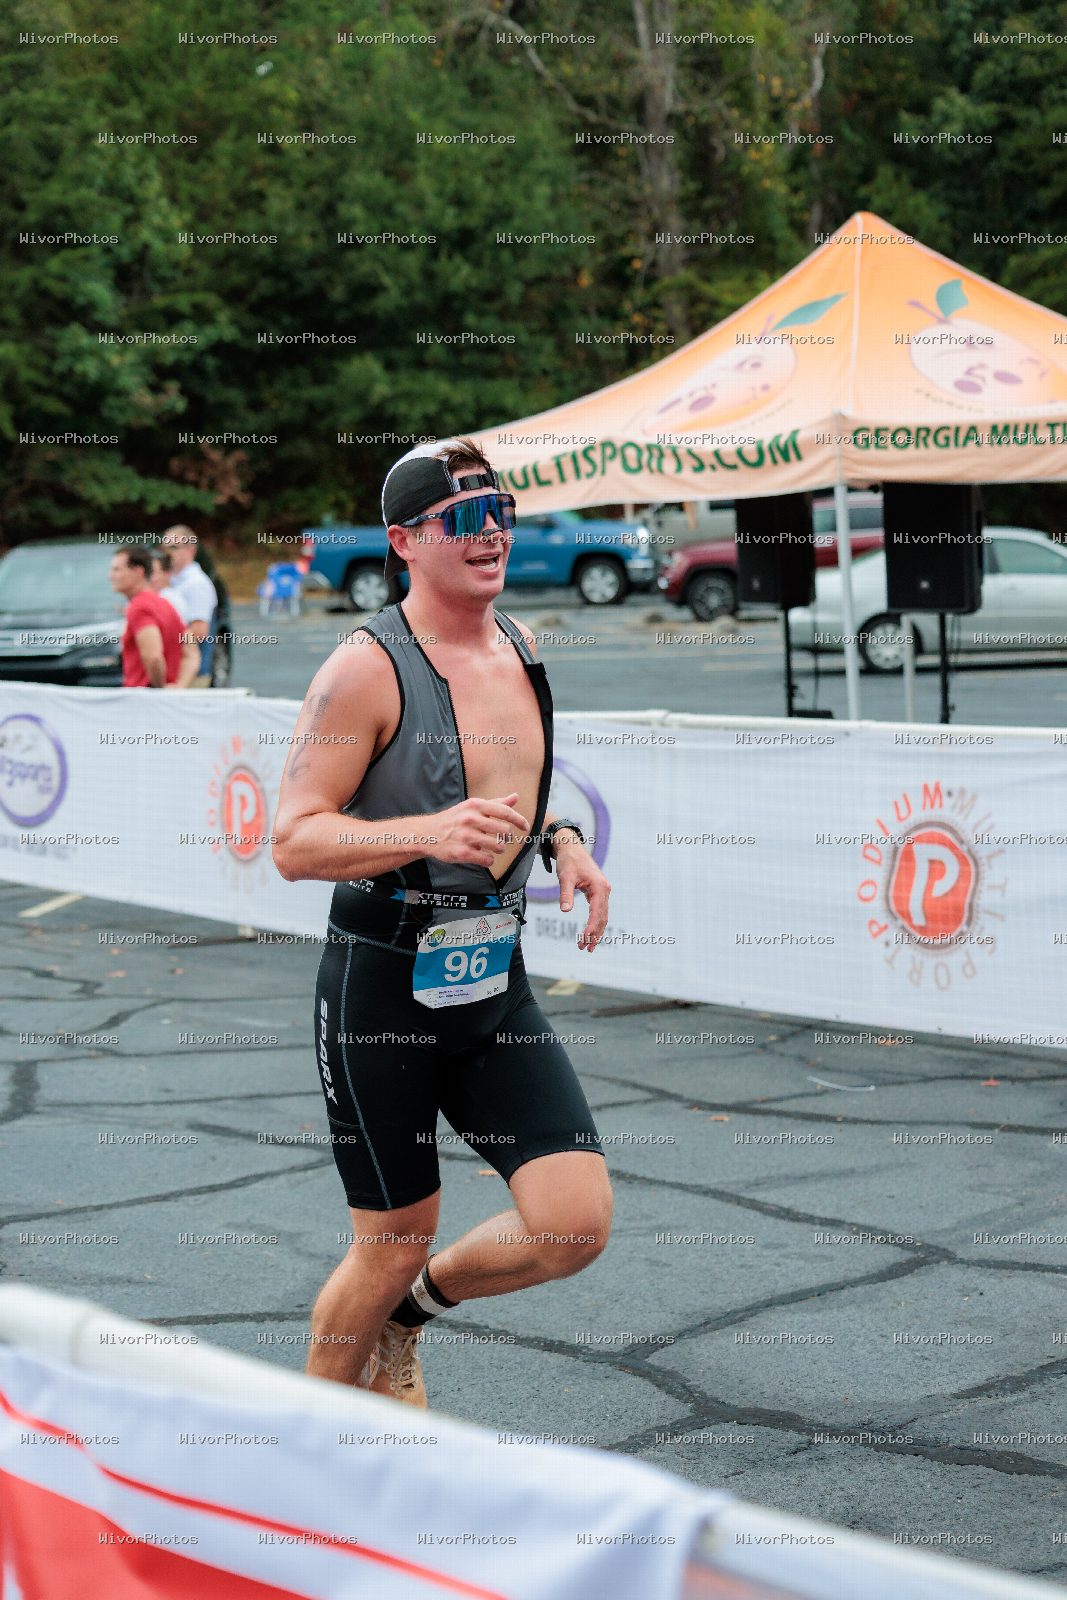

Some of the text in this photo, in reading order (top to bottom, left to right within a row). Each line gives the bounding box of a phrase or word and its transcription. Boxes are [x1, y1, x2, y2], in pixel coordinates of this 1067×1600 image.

[857, 781, 944, 939] PODIUM
[417, 899, 467, 908] ETSUITS
[444, 946, 490, 982] 96
